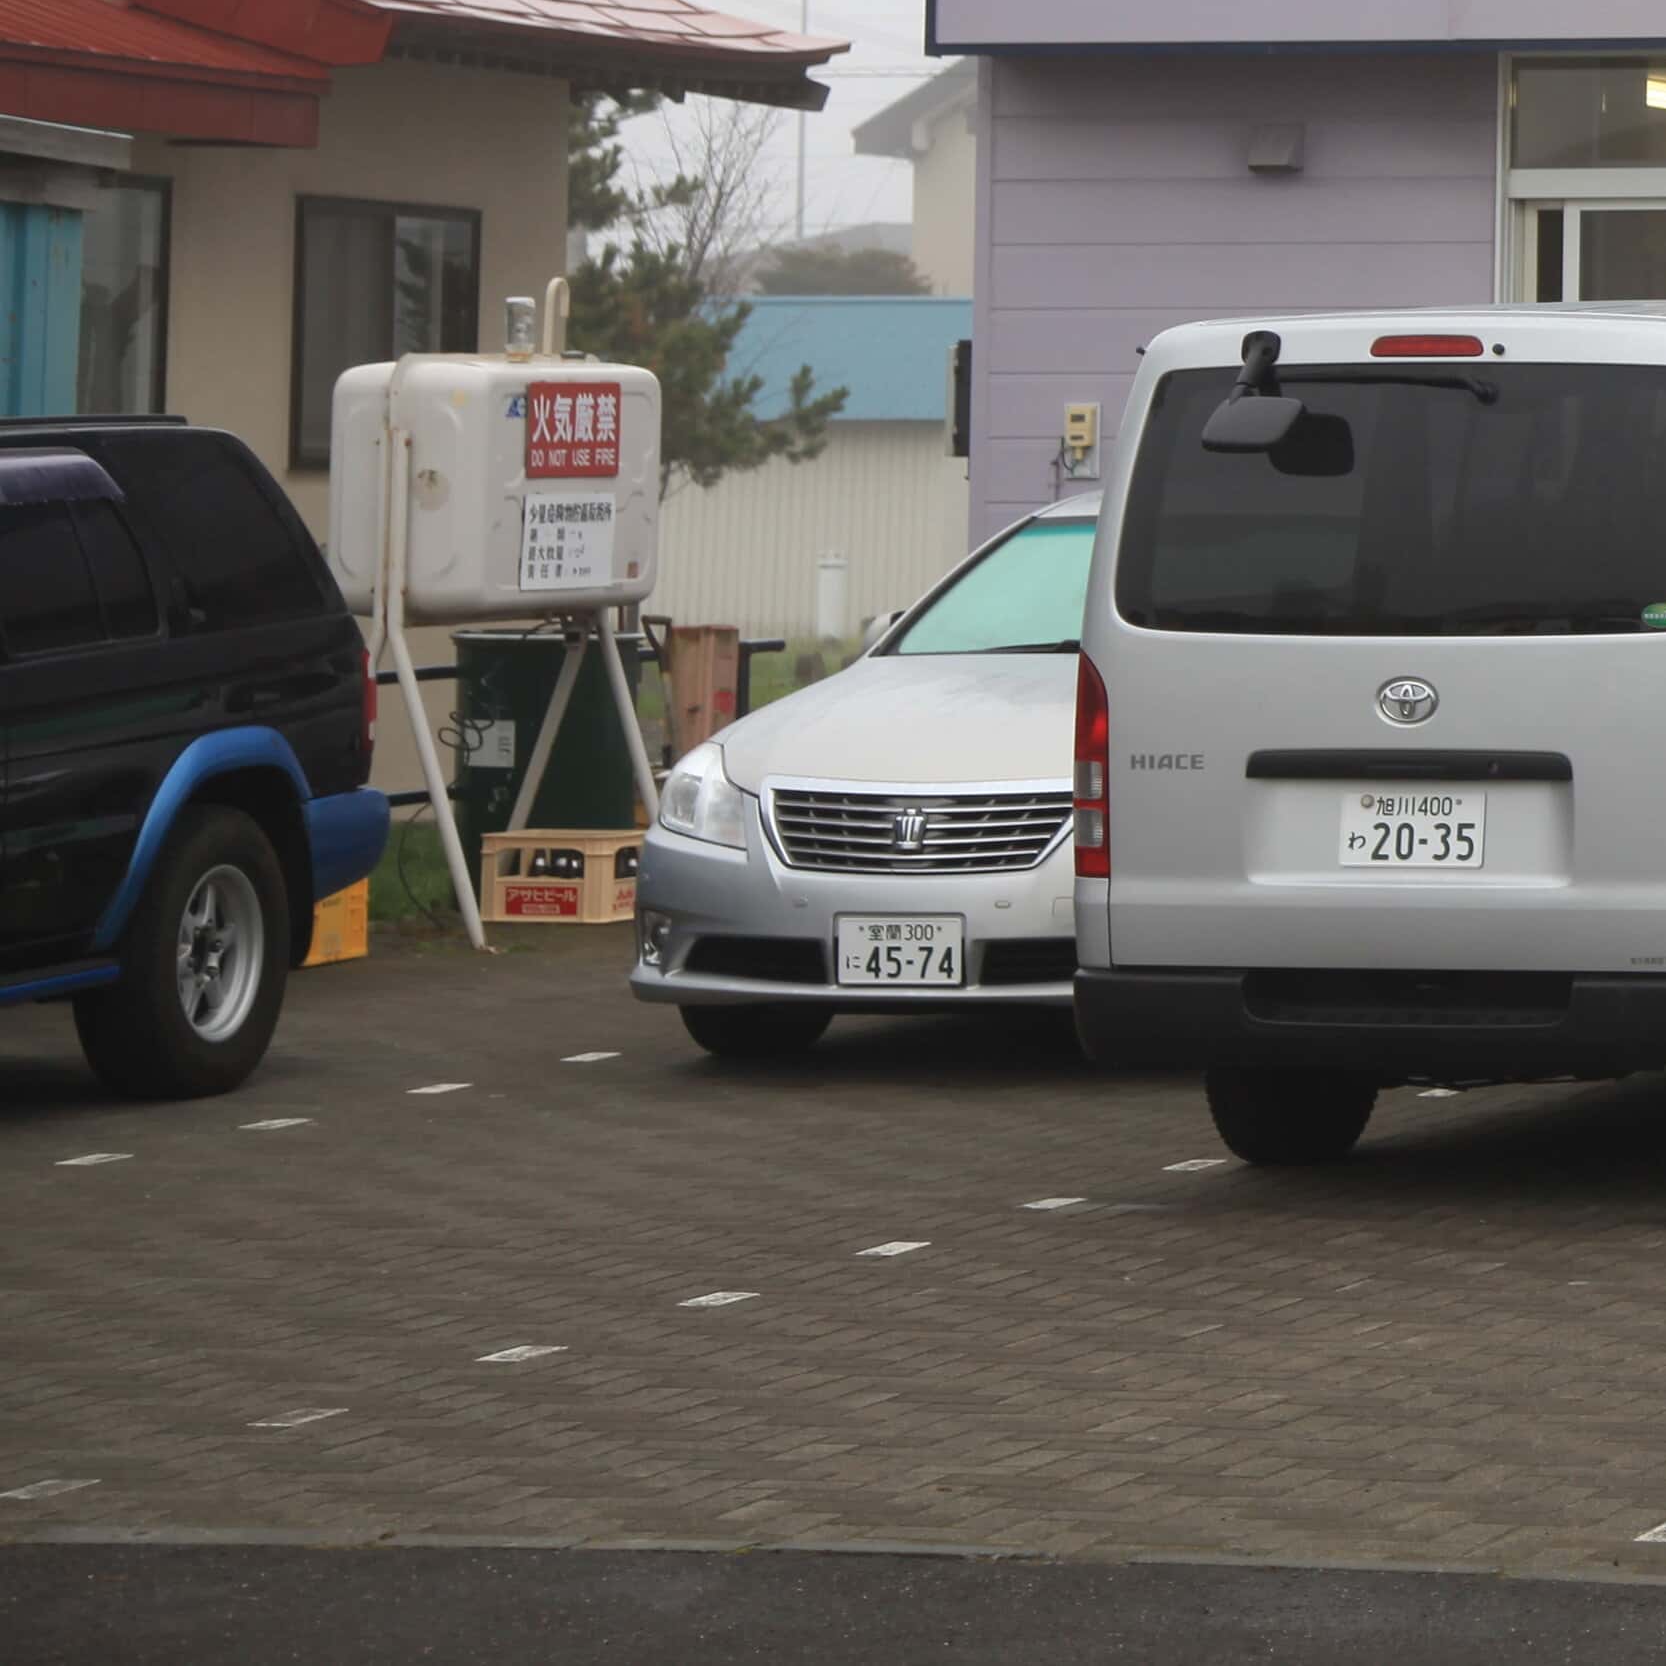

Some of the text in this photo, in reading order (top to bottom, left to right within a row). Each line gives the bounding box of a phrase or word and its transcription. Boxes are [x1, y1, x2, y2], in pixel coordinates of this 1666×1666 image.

[532, 393, 617, 443] 火気厳禁
[531, 447, 616, 467] DO NOT USE FIRE
[1130, 754, 1205, 770] HIACE
[1348, 822, 1475, 861] わ 20-35
[506, 888, 576, 902] アサヒビール
[846, 946, 954, 979] に 45-74
